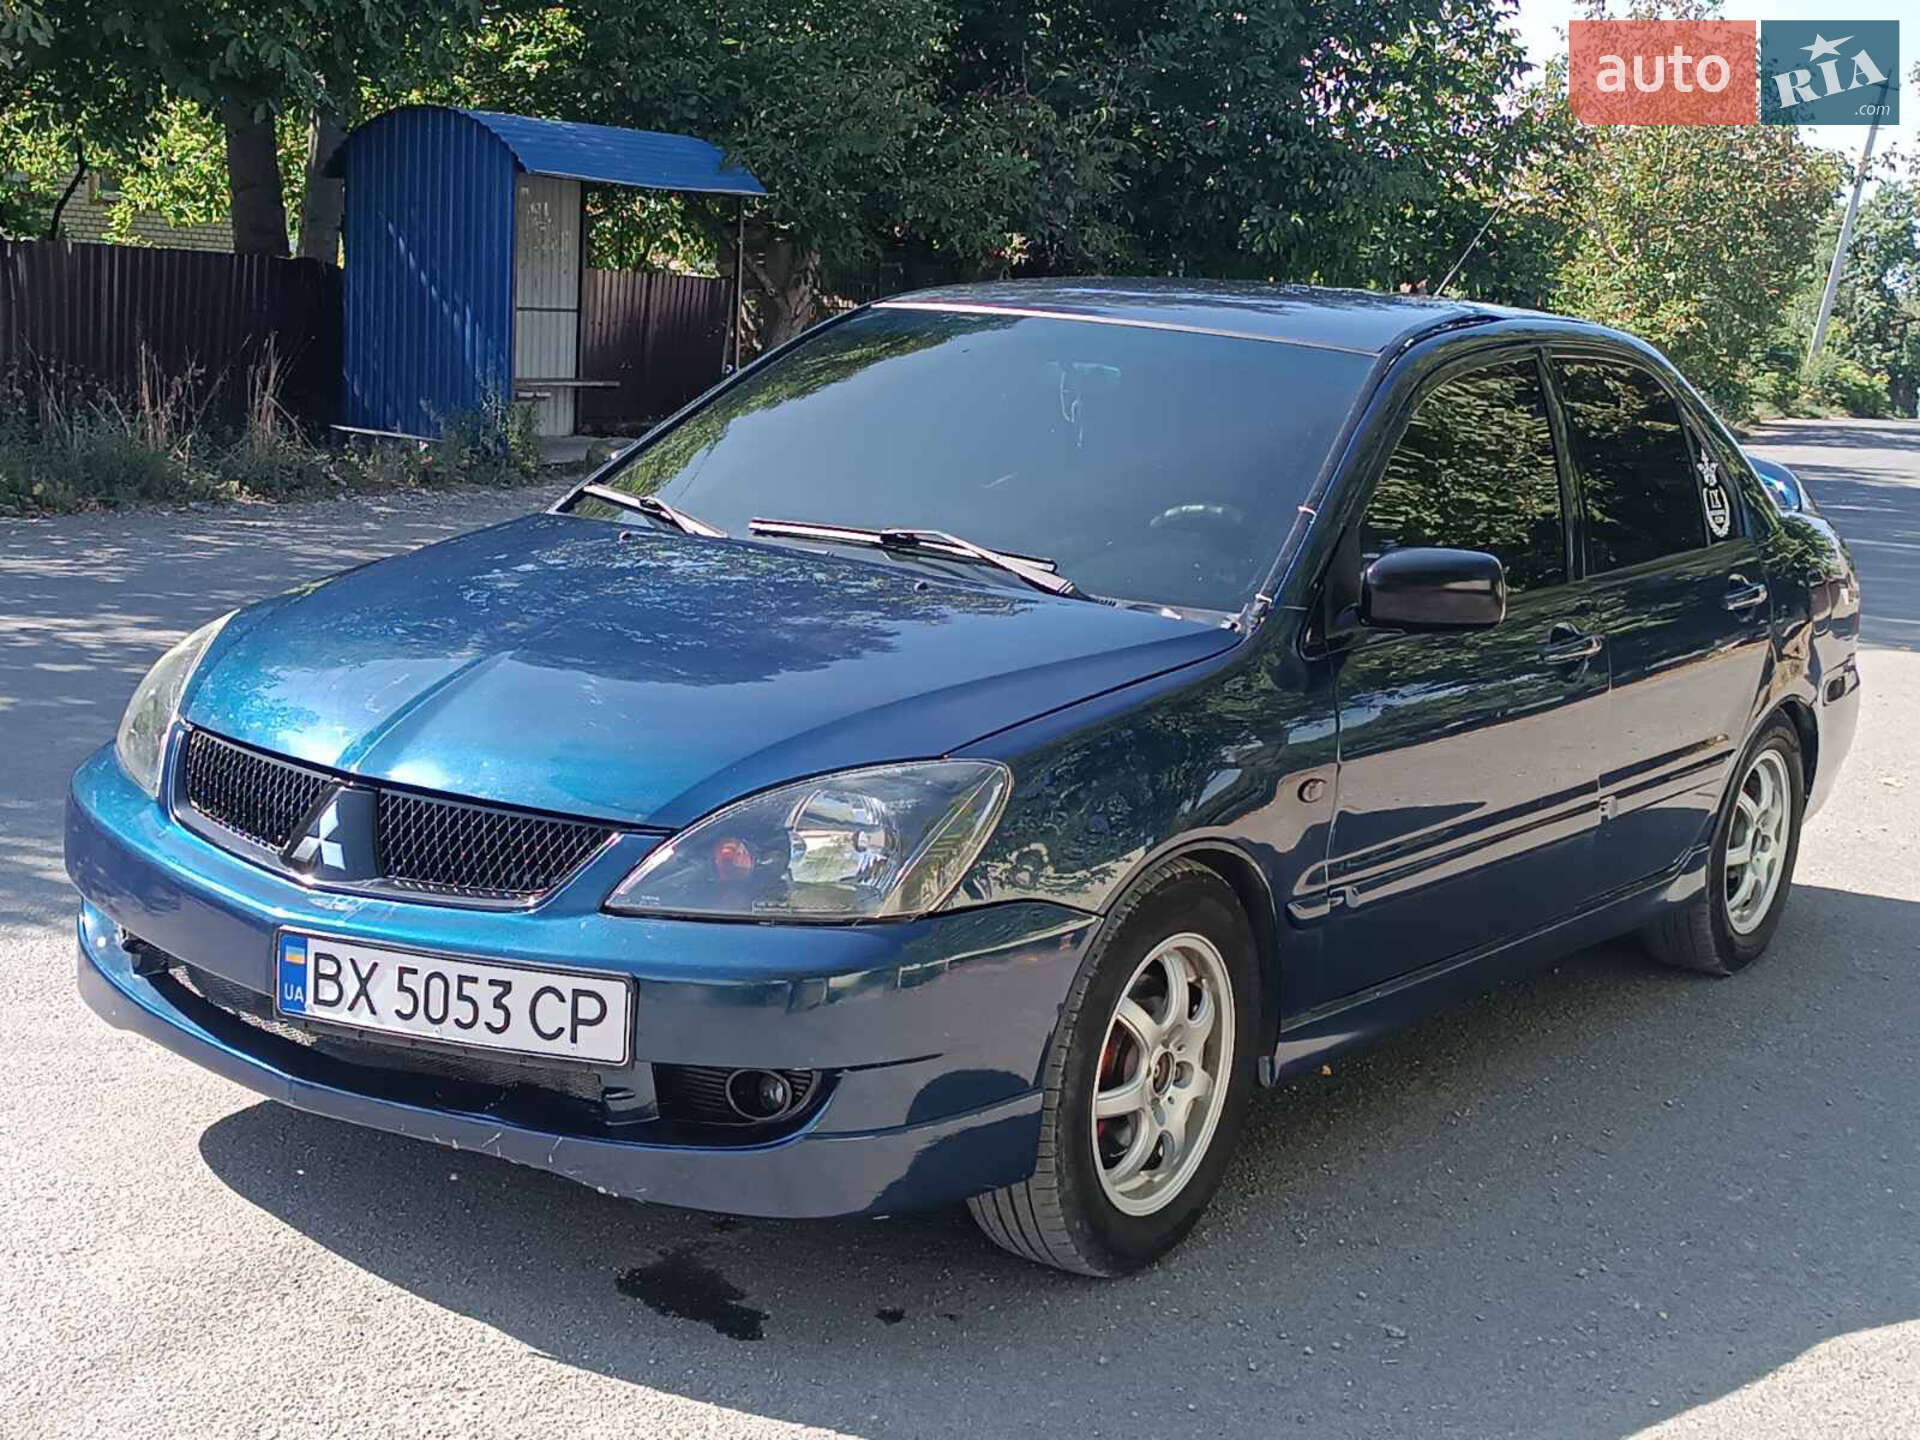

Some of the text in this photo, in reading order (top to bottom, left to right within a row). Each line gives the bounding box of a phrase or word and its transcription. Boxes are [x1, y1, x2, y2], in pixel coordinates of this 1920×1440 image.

[284, 983, 304, 1002] UA
[313, 952, 607, 1043] BX 5053 CP
